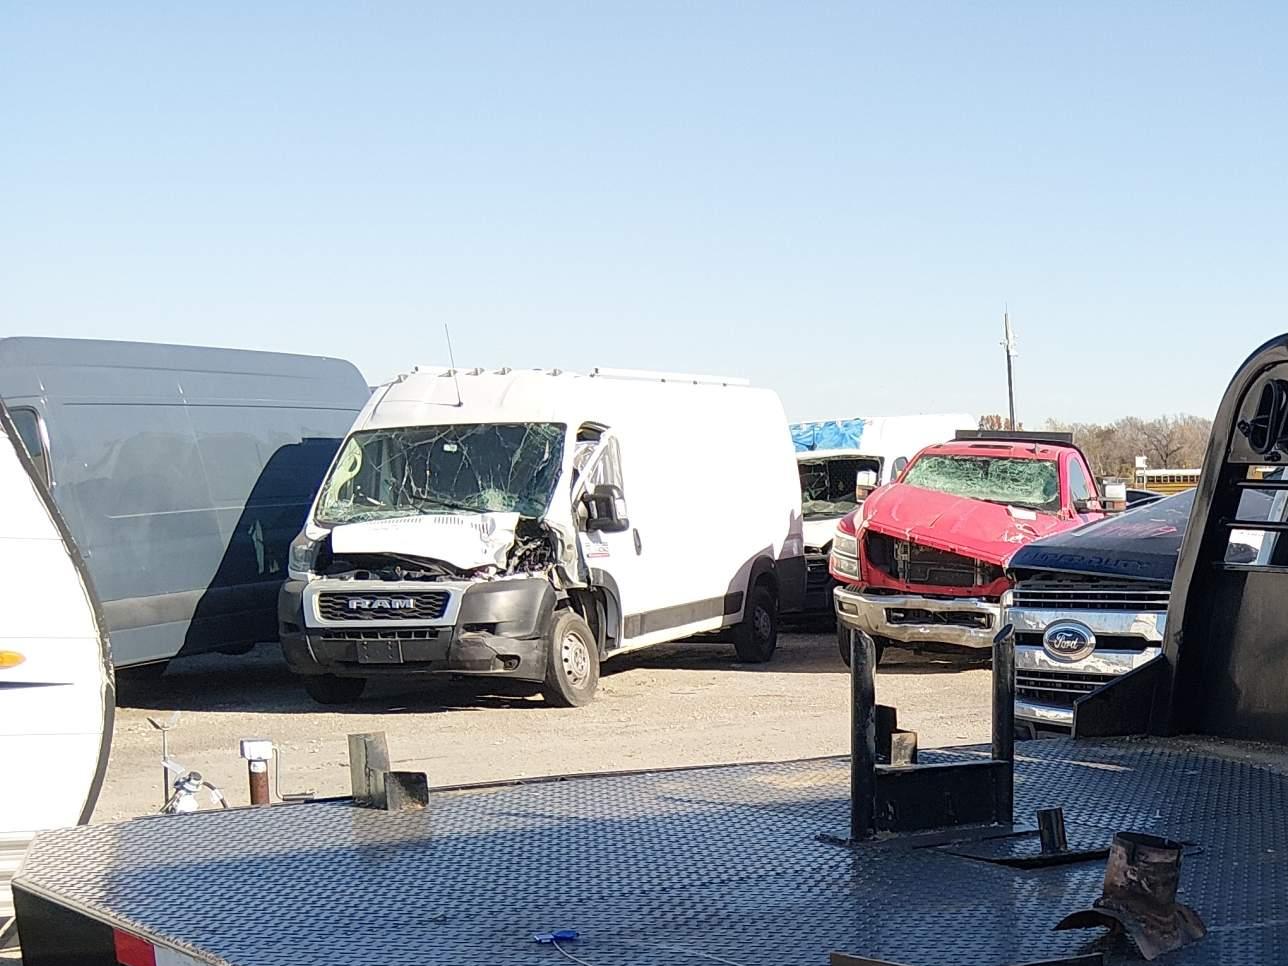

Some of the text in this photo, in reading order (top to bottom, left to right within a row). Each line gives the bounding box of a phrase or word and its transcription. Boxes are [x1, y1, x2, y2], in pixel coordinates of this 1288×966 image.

[1092, 556, 1150, 570] DUTY
[348, 598, 415, 609] RAM
[1054, 631, 1080, 650] Ford
